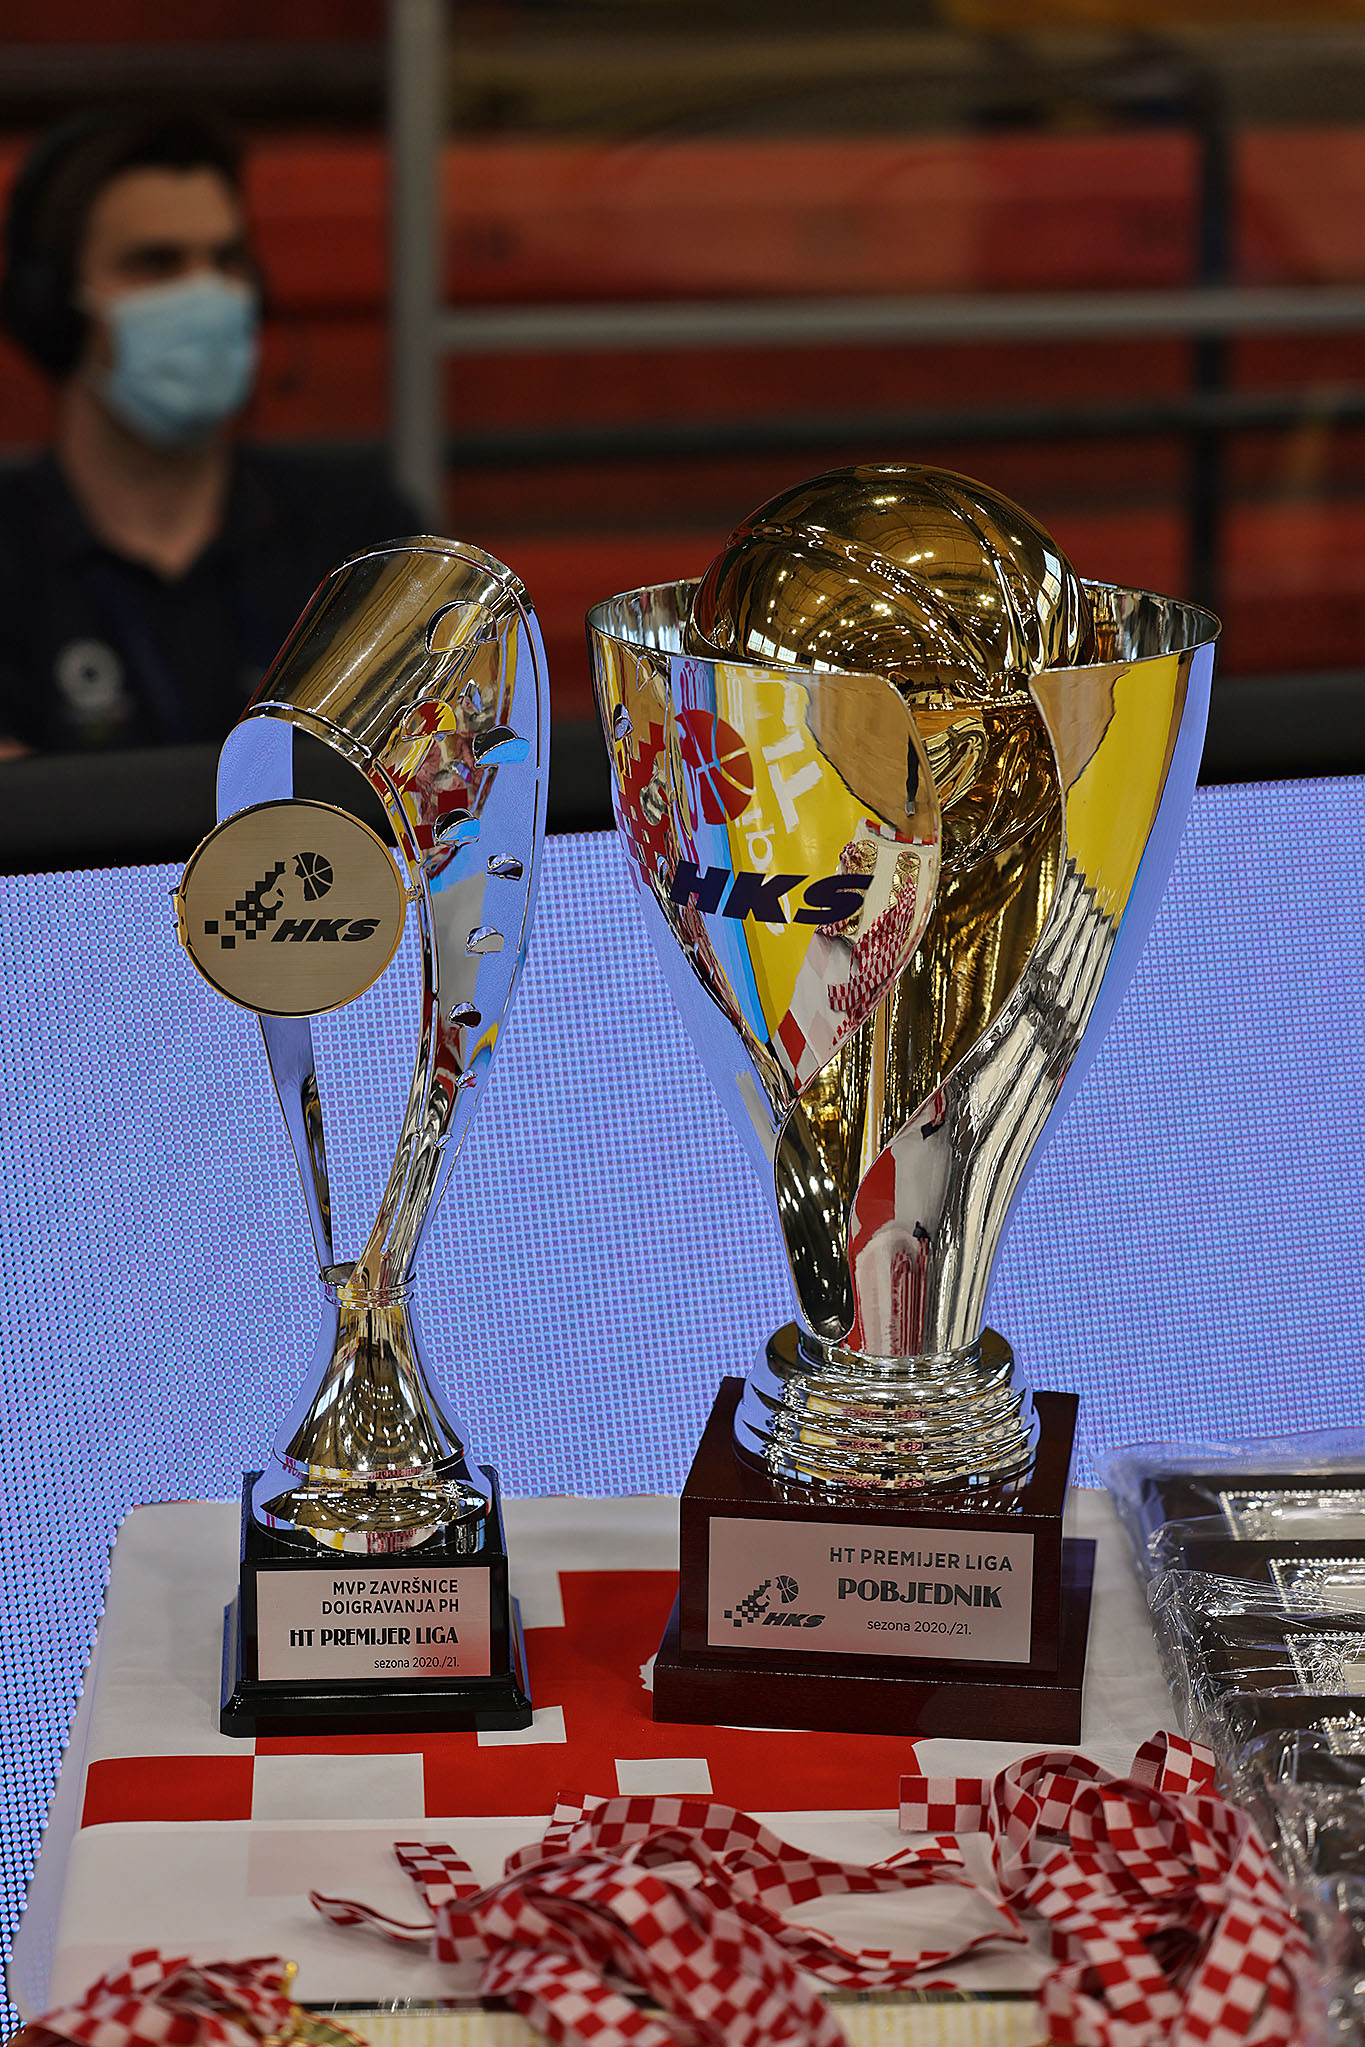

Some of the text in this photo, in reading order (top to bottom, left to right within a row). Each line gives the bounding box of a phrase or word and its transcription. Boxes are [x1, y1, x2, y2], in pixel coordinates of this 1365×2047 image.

[668, 860, 874, 925] HKS
[271, 918, 381, 943] HKS
[829, 1547, 1013, 1572] HT PREMIJER LIGA
[333, 1577, 458, 1596] MVP ZAVRŠNICE
[837, 1577, 1003, 1609] POBJEDNIK
[321, 1599, 459, 1615] DOIGRAVANJA PH
[761, 1612, 826, 1628] HKS
[867, 1619, 972, 1636] sezona 2020./21.
[289, 1626, 459, 1647] HT PREMIJER LIGA
[374, 1656, 460, 1669] sezona 2020./21.
